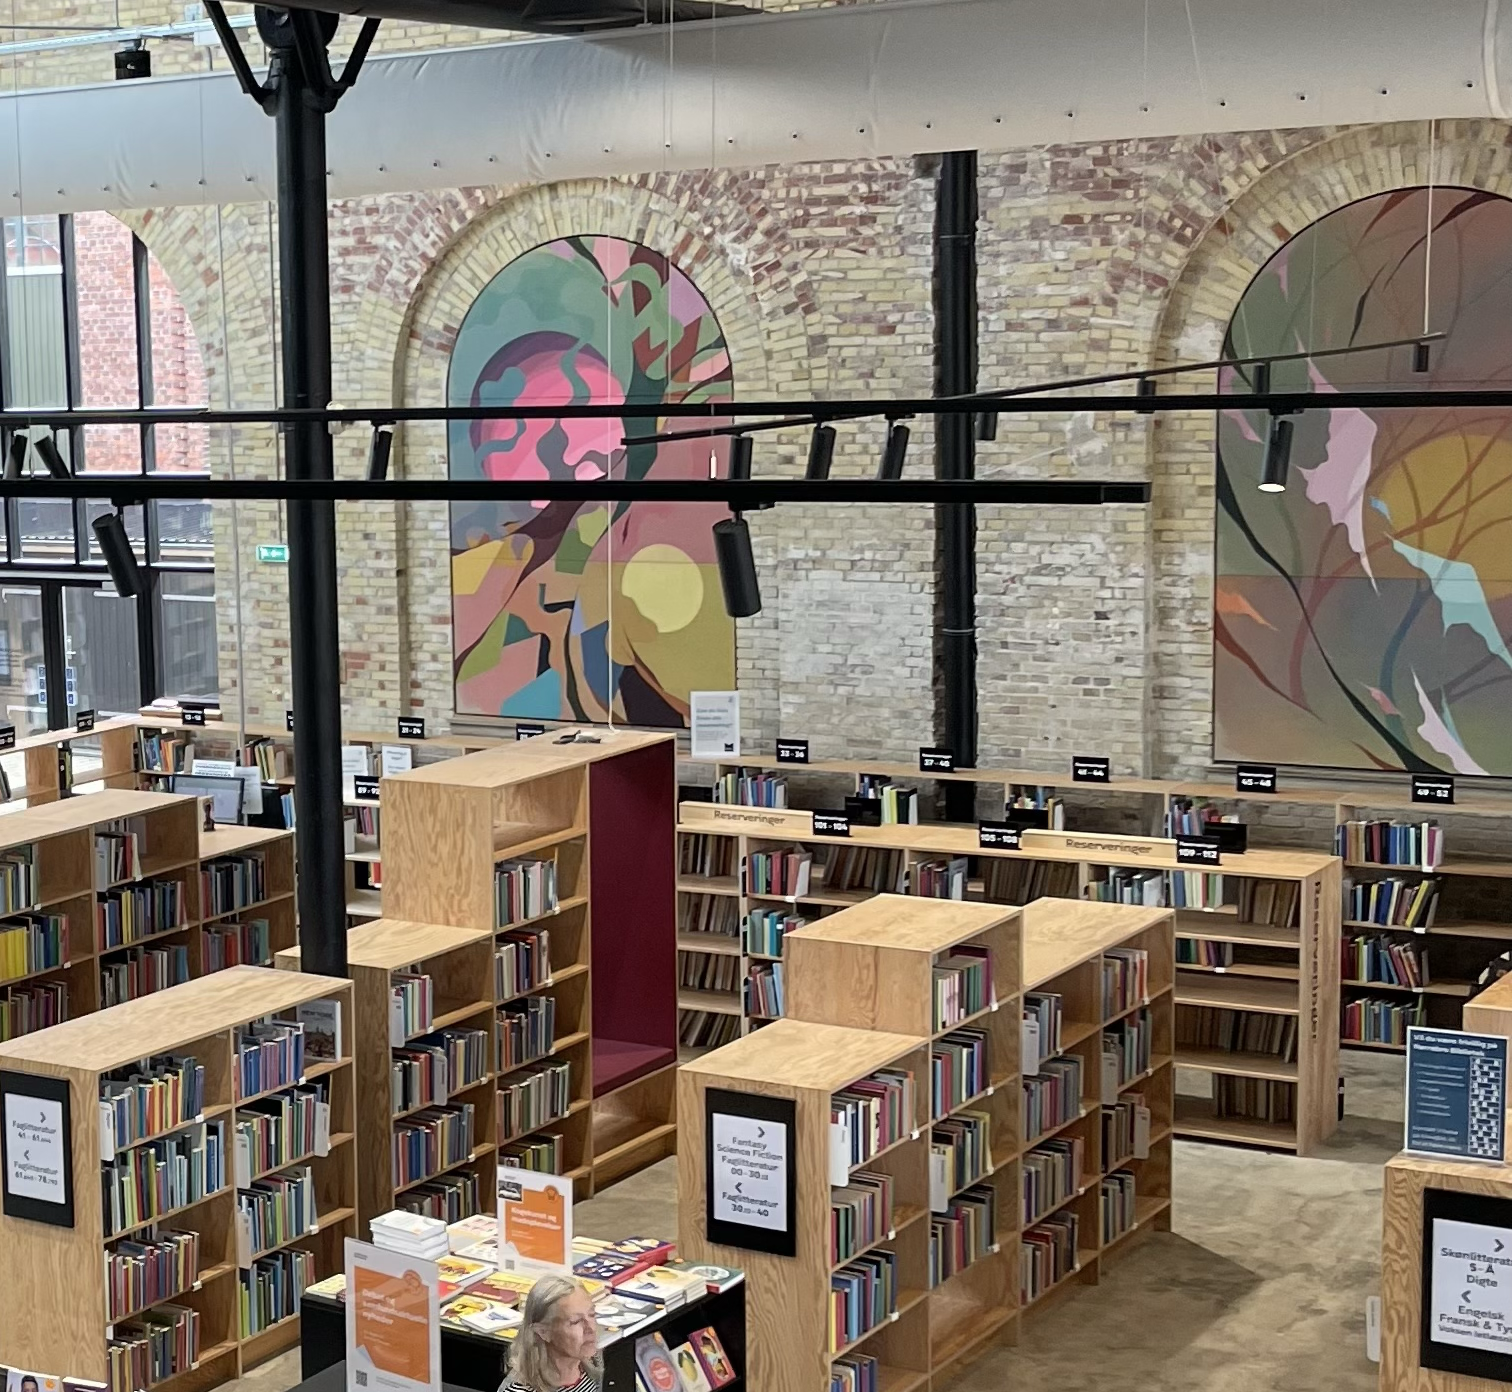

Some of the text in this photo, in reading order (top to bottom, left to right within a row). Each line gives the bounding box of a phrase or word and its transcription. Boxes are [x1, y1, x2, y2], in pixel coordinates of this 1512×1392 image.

[714, 809, 786, 826] Reserveringer
[1066, 838, 1153, 856] Reserveringer
[716, 1144, 783, 1161] Science Fiction
[732, 1137, 767, 1151] Fantasy
[721, 1155, 779, 1171] Faglitteratur
[722, 1191, 779, 1208] Faglitteratur
[1466, 1274, 1498, 1288] Digte
[1458, 1305, 1506, 1320] Engelsk
[1439, 1313, 1480, 1328] Fransk
[1483, 1320, 1493, 1330] &
